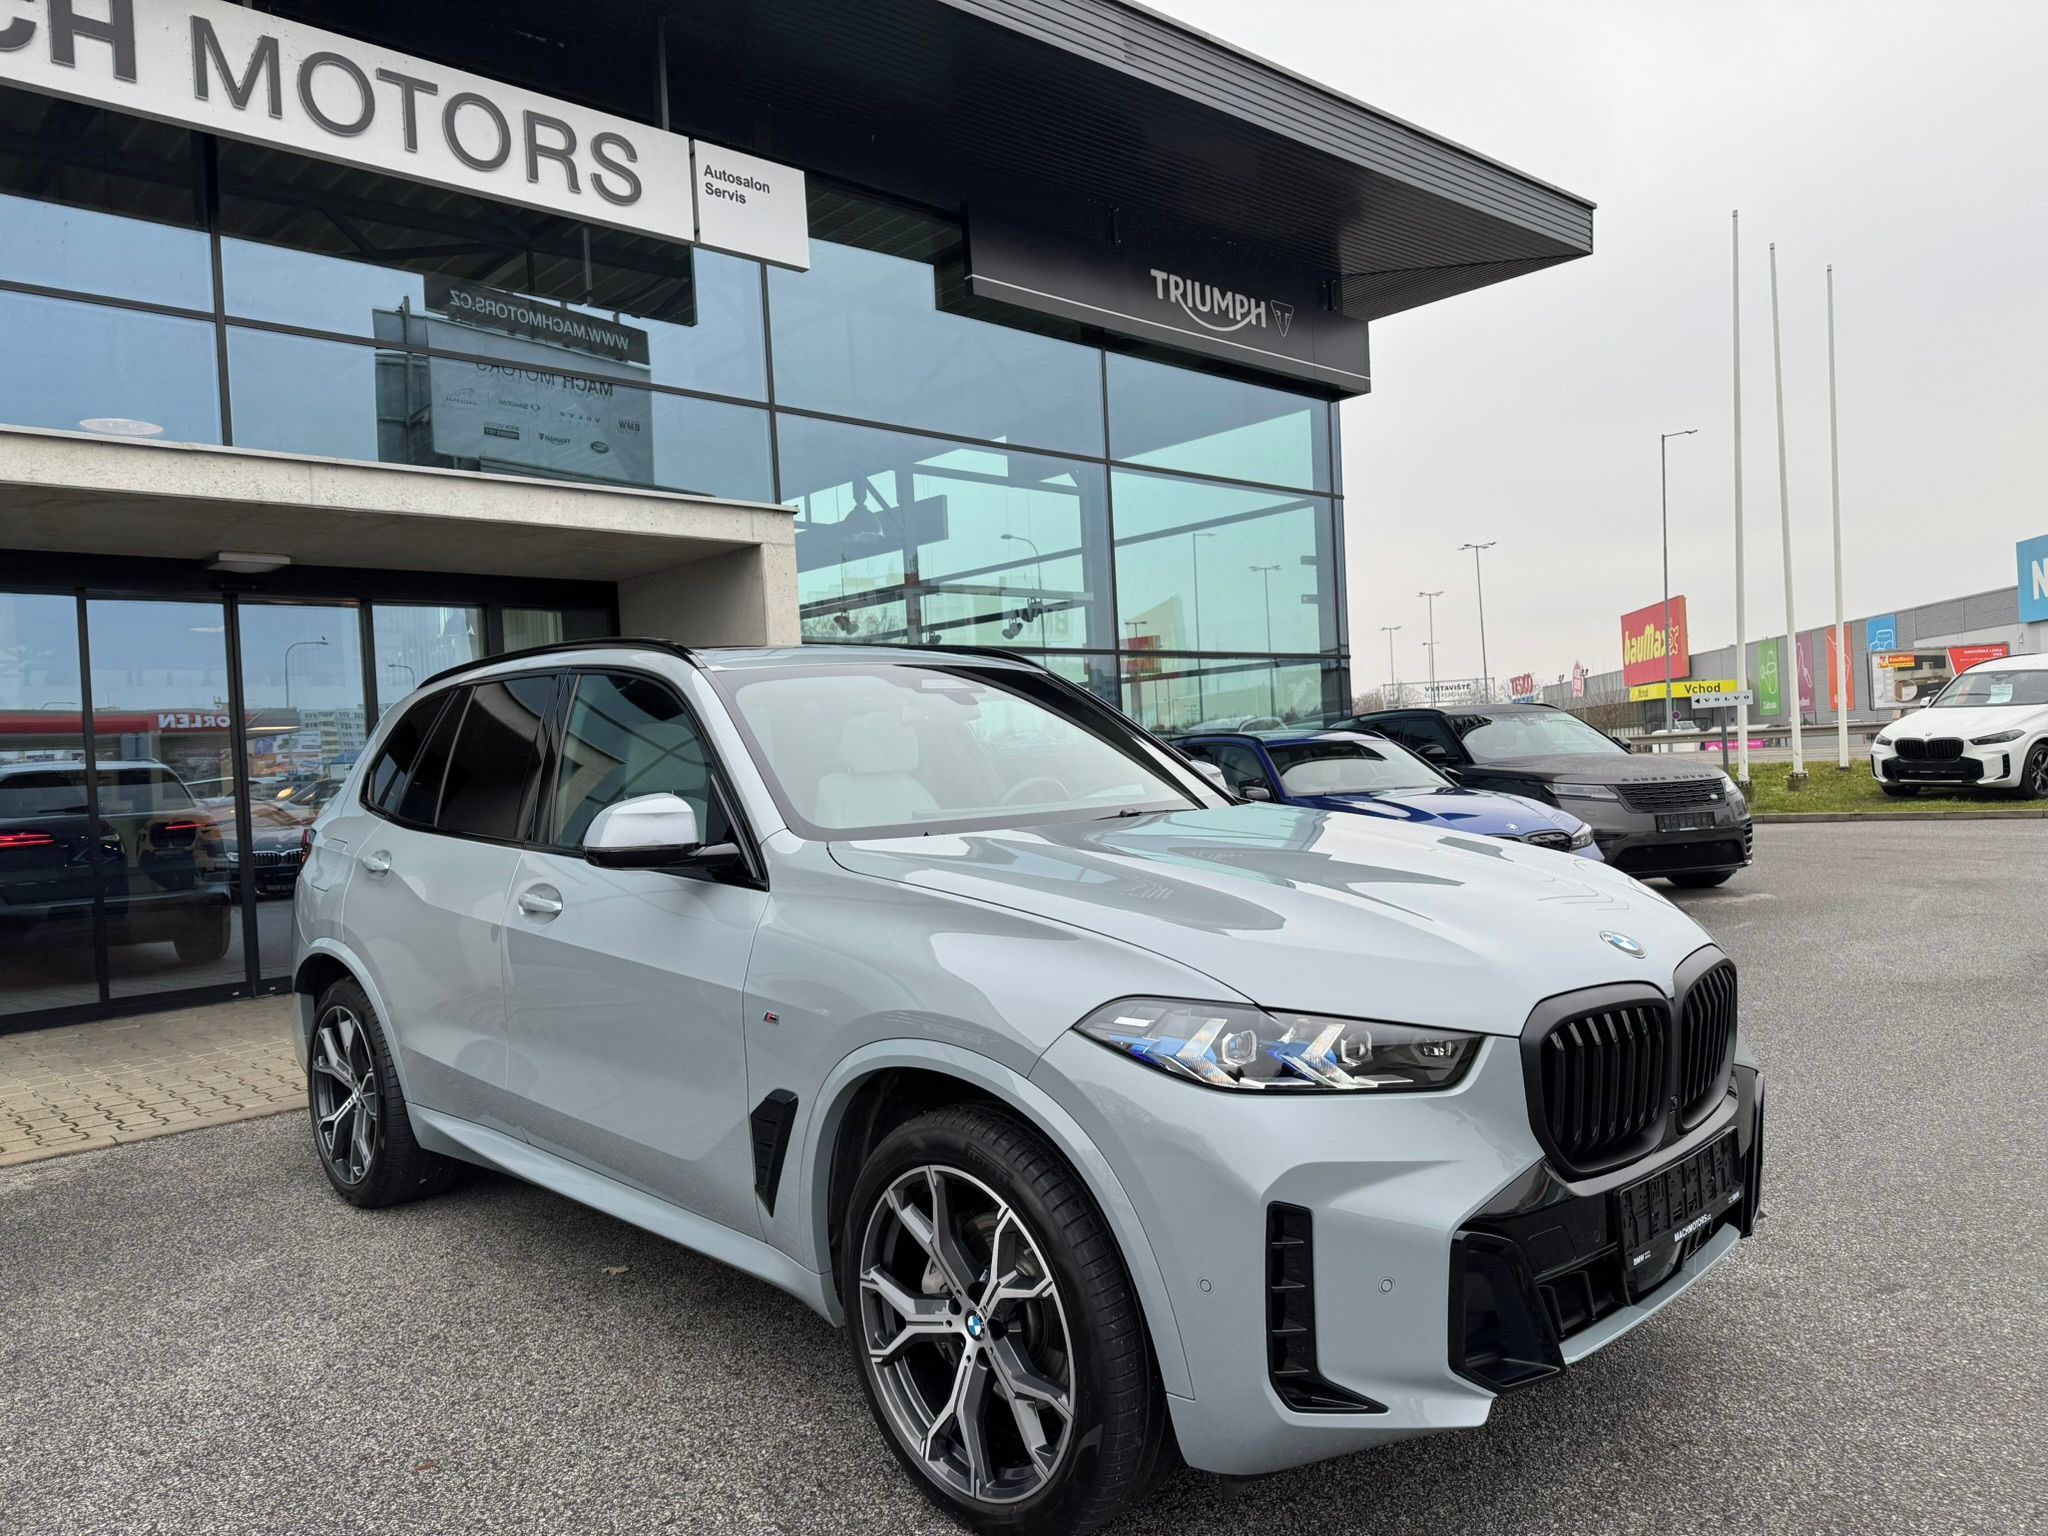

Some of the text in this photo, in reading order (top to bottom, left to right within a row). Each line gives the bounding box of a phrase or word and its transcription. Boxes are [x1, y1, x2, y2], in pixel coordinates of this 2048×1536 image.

[0, 0, 642, 206] H MOTORS
[704, 164, 770, 194] Autosalon
[705, 182, 746, 204] Servis
[1151, 268, 1266, 331] TRIUMPH
[1685, 683, 1720, 694] Vchod
[1704, 694, 1750, 702] VOLVO
